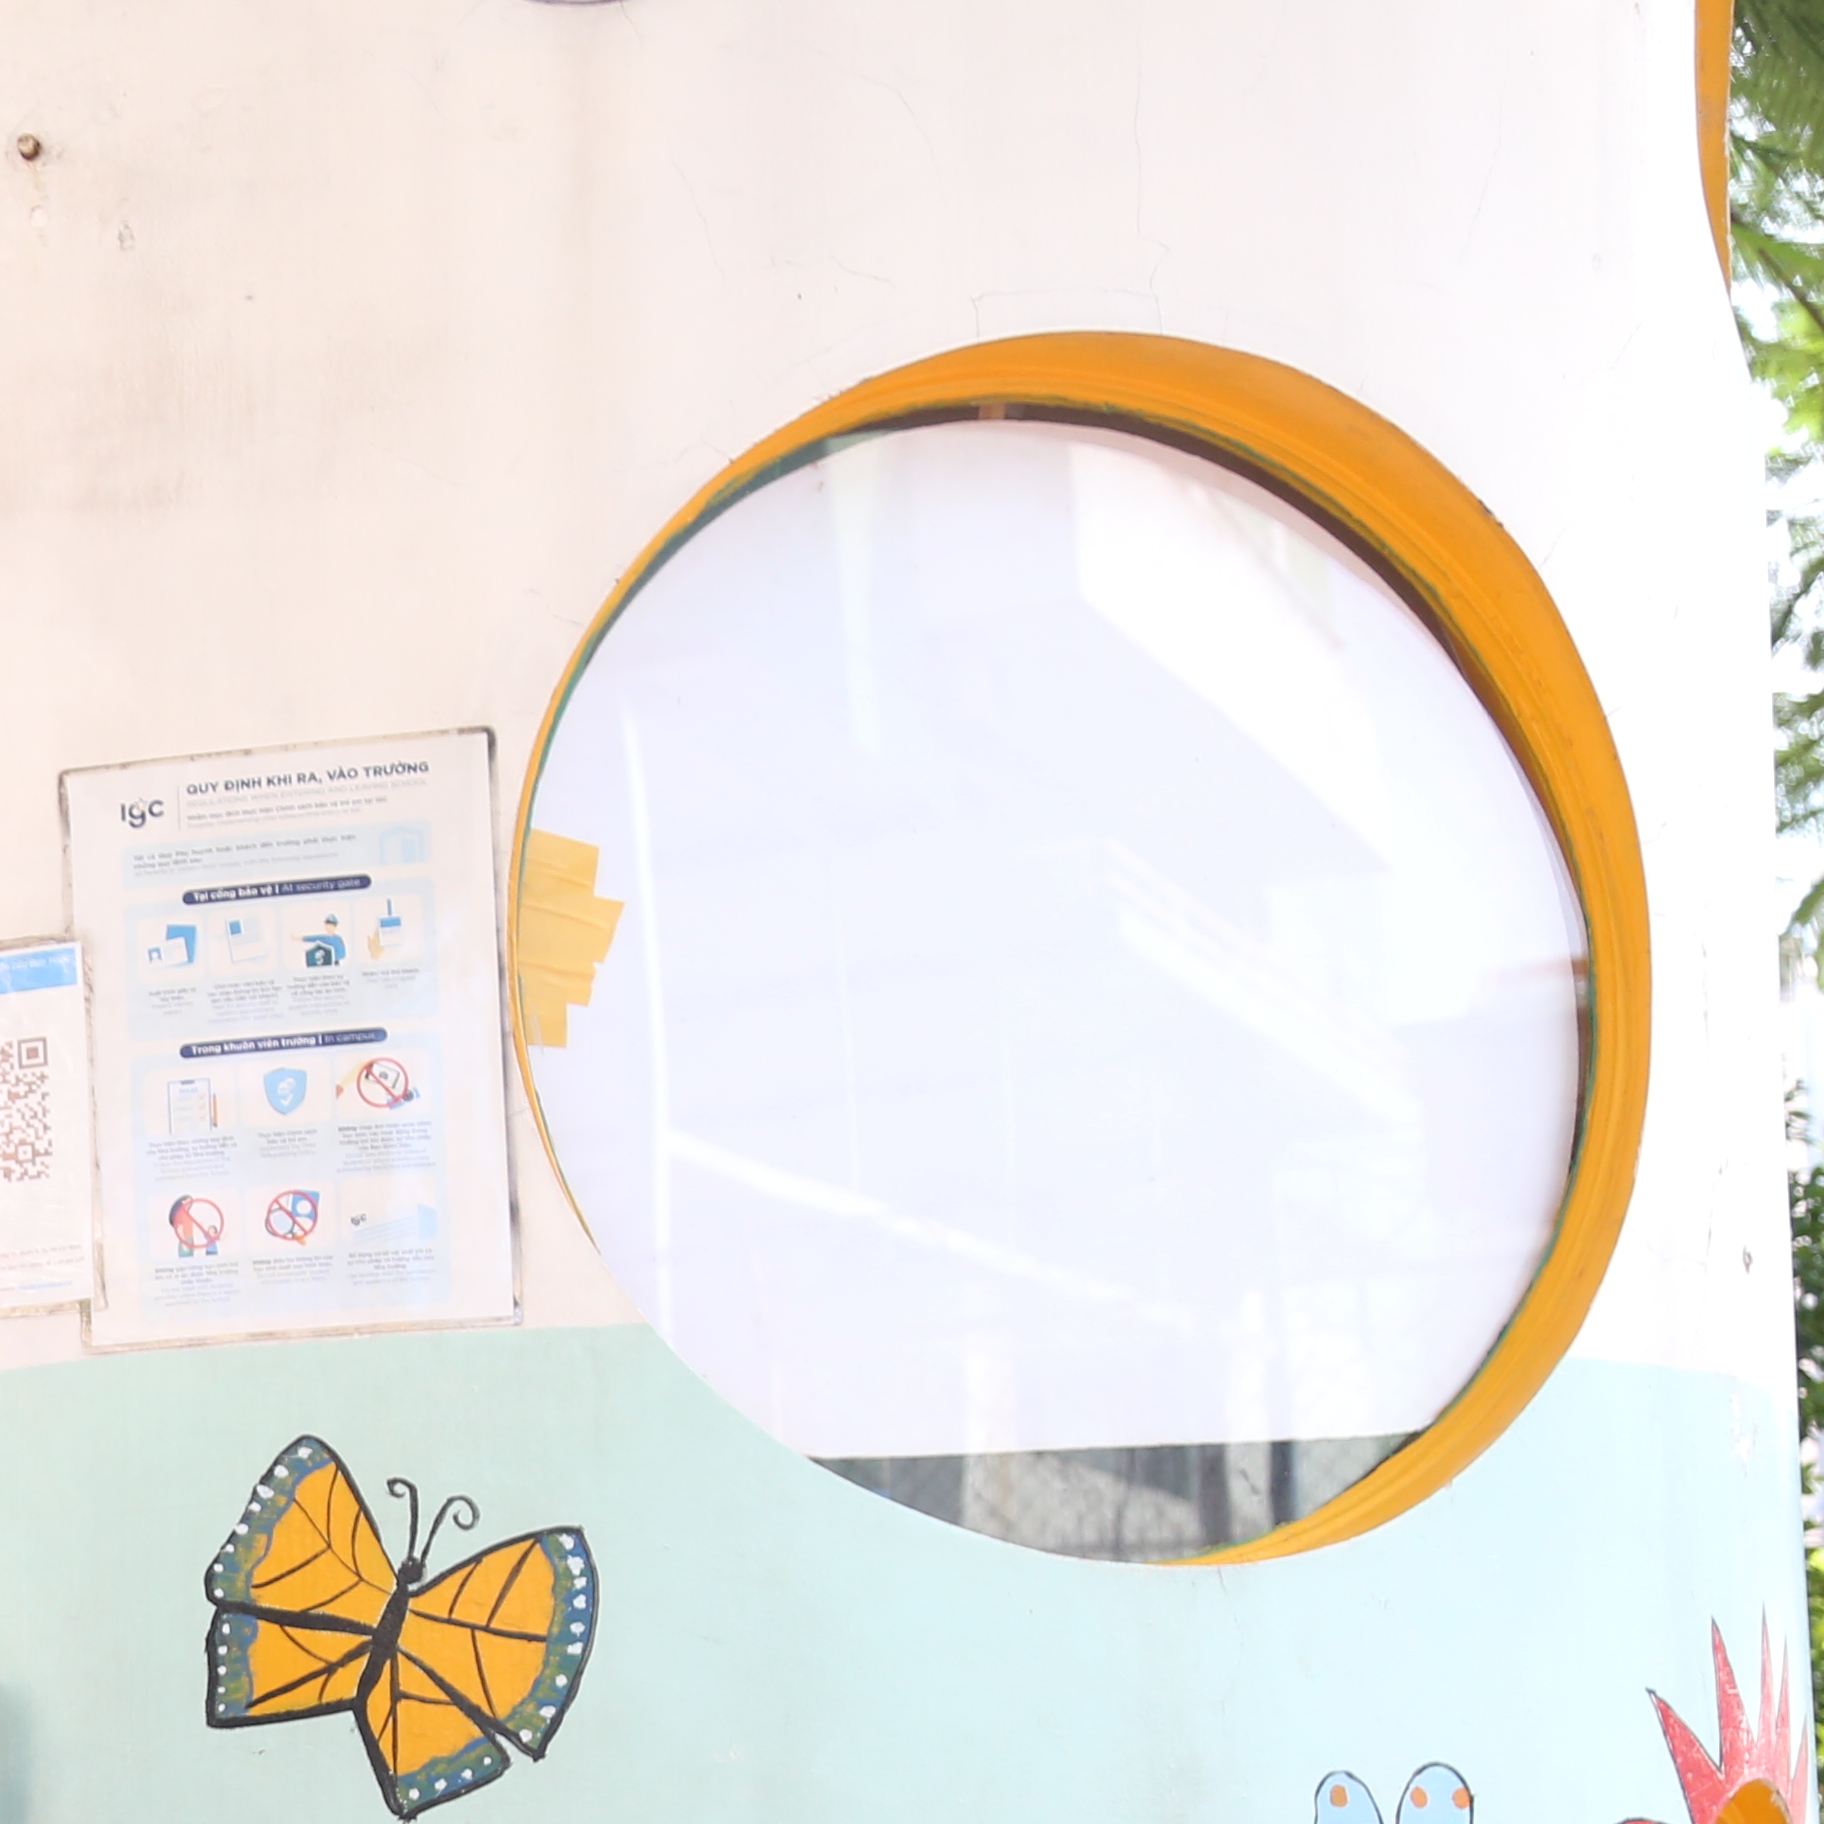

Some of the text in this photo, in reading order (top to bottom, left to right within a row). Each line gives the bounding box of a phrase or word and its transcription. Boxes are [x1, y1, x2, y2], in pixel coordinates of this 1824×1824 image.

[186, 761, 430, 796] QUY ĐỊNH KHI RA, VÀO TRƯỜNG
[191, 1044, 221, 1056] Trong
[223, 1040, 254, 1051] khuôn
[257, 1038, 279, 1049] viên
[281, 1036, 316, 1048] trường
